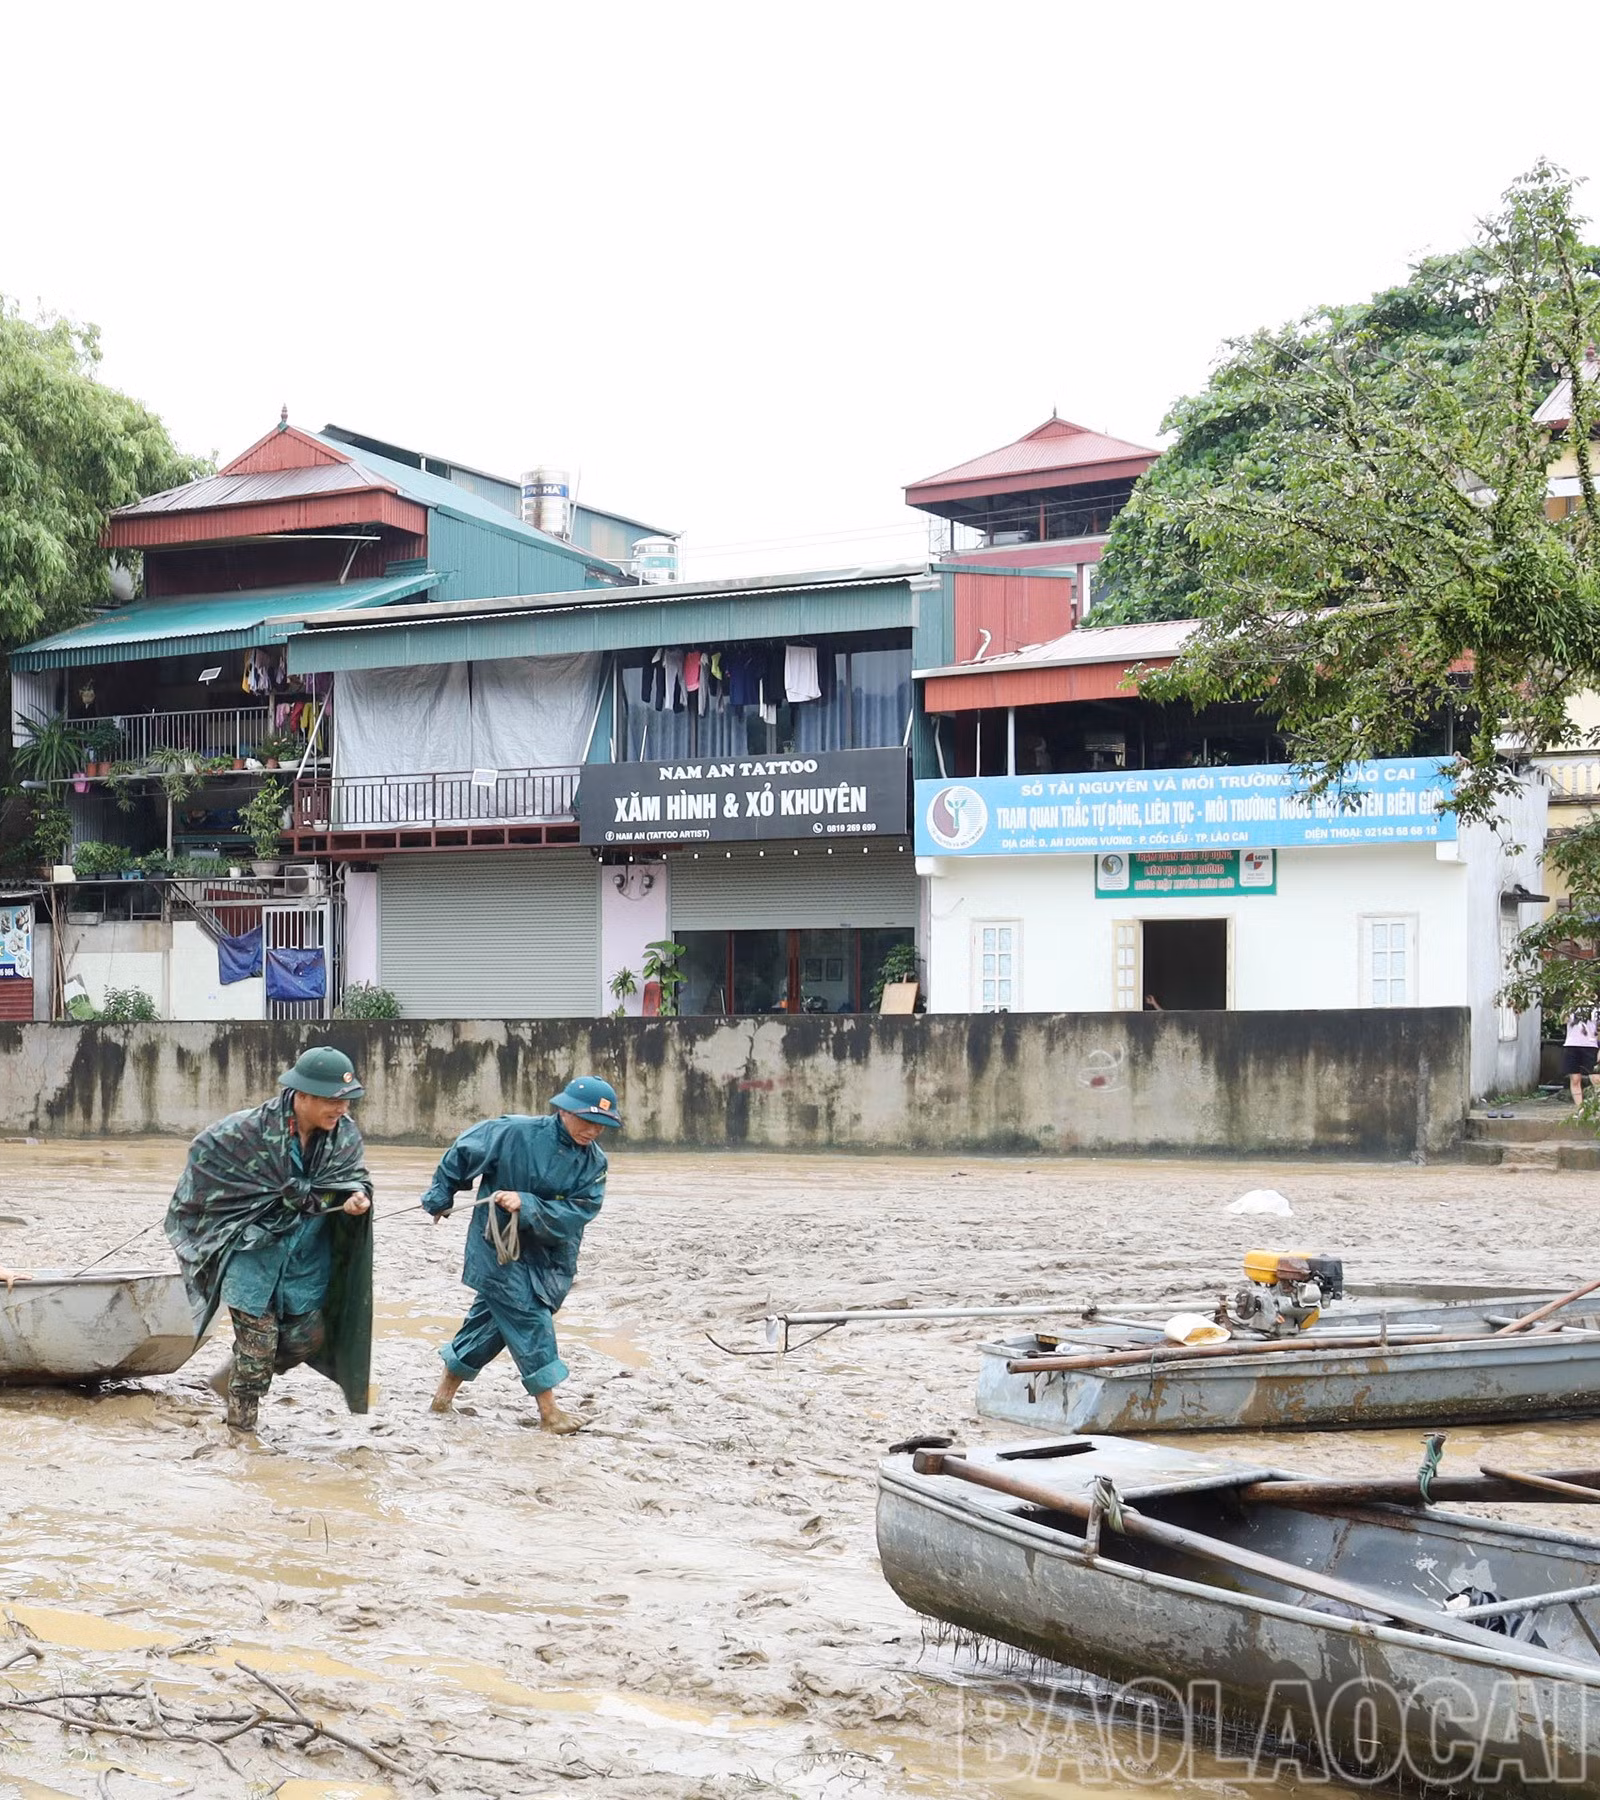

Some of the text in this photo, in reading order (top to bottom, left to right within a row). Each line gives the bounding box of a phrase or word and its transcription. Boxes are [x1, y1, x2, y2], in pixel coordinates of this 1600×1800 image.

[659, 758, 818, 781] NAM AN TATTOO
[1021, 783, 1043, 797] SỞ
[1050, 780, 1074, 795] TÀI
[1079, 778, 1148, 795] NGUYÊN
[1153, 775, 1178, 791] VÀ
[1182, 774, 1214, 790] MÔI
[1219, 772, 1291, 789] TRƯỜNG
[1384, 767, 1416, 782] CAI
[614, 782, 867, 823] XĂM HÌNH & XỎ KHUYÊN
[996, 807, 1028, 834] TRẠM
[1029, 806, 1059, 830] QUAN
[1061, 797, 1090, 828] TRẮC
[1092, 802, 1107, 831] TỰ
[1145, 797, 1171, 824] LIÊN
[1172, 801, 1195, 828] TỤC
[1205, 794, 1228, 823] MÔI
[1231, 792, 1277, 822] TRƯỜNG
[1386, 787, 1415, 816] BIÊN
[615, 828, 710, 841] NAM AN (TATTOO ARTIST)
[1050, 838, 1064, 848] AN
[1149, 830, 1169, 844] CỐC
[1171, 829, 1188, 844] LẾU
[1195, 833, 1209, 843] TP.
[1211, 830, 1230, 843] LÀO
[1232, 832, 1249, 842] CAI
[1330, 828, 1362, 842] THOẠI:
[1364, 827, 1395, 838] 02143
